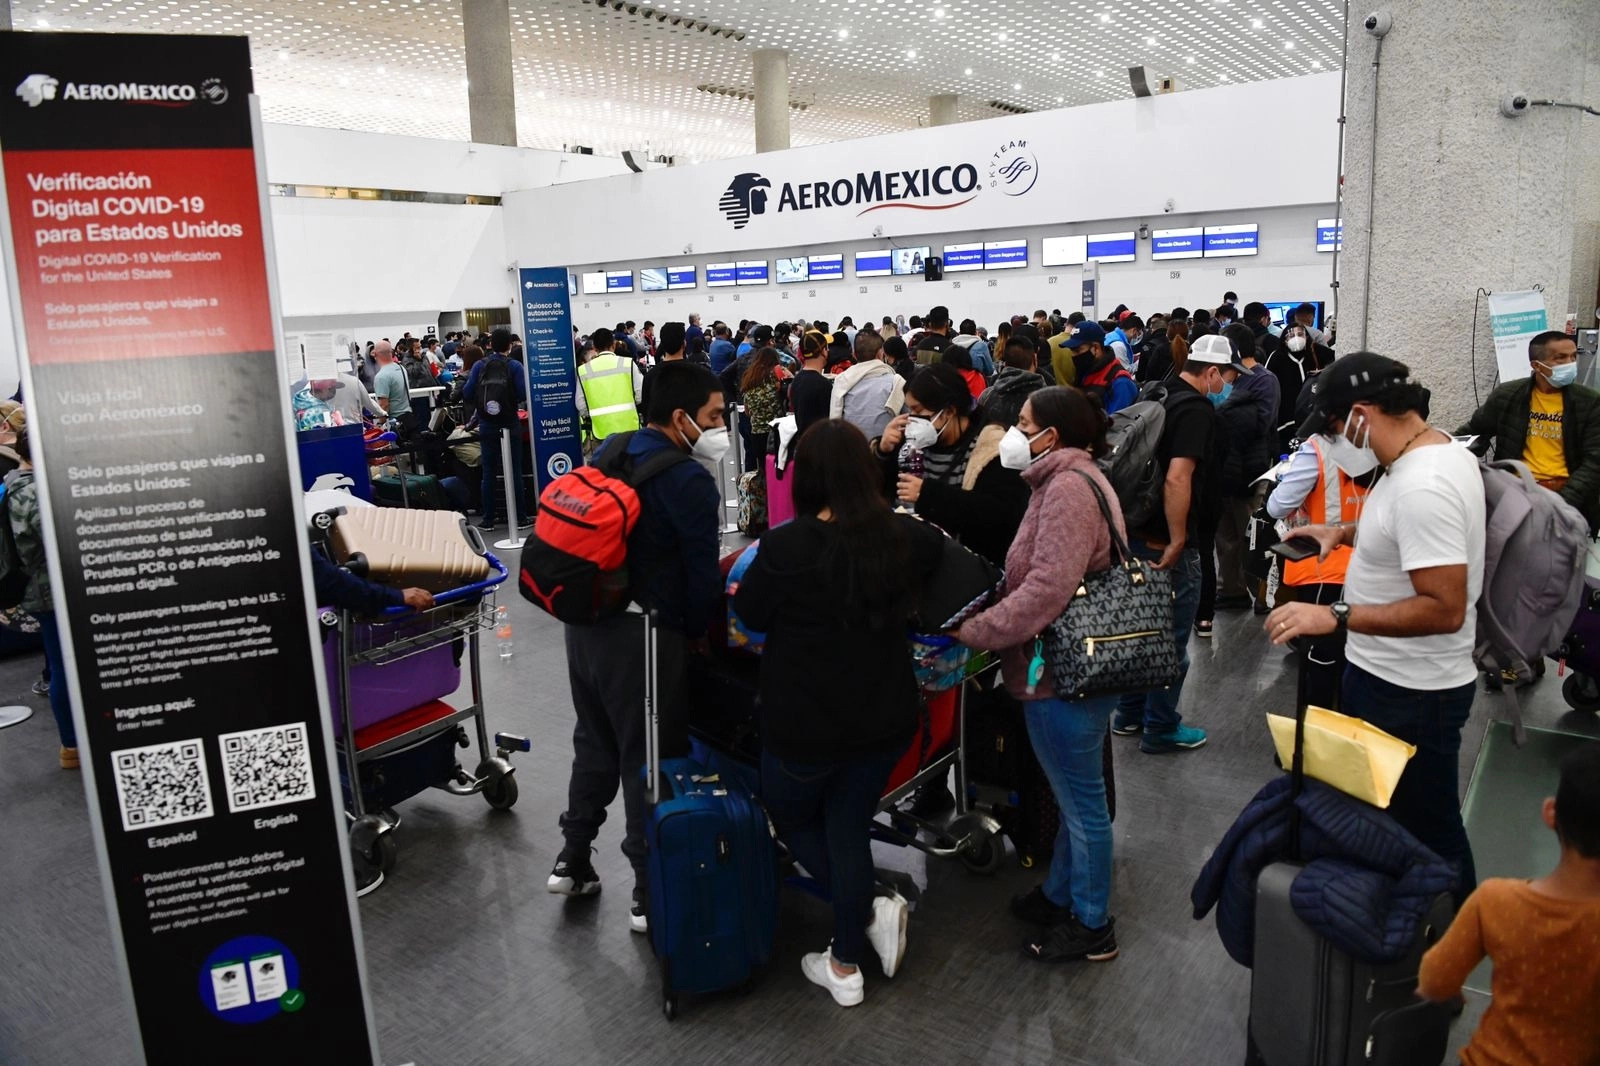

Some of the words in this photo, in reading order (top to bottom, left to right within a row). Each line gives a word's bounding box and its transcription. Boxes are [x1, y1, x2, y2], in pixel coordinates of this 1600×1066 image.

[63, 82, 196, 101] AEROMEXICO
[989, 139, 1027, 188] SKYTEAM
[27, 172, 151, 192] Verificación
[777, 163, 979, 213] AEROMEXICO
[32, 199, 99, 220] Digital
[103, 196, 205, 215] COVID-19
[35, 228, 82, 247] para
[86, 224, 169, 242] Estados
[172, 221, 243, 239] Unidos
[38, 254, 81, 269] Digital
[83, 252, 149, 267] COVID-19
[150, 250, 221, 264] Verification
[40, 272, 58, 284] for
[61, 271, 84, 283] the
[86, 269, 130, 282] United
[131, 267, 173, 280] States
[1049, 276, 1057, 284] 37
[1170, 271, 1180, 279] 39
[44, 302, 75, 316] Solo
[77, 299, 141, 316] pasajeros
[143, 299, 168, 312] que
[170, 296, 208, 311] viajan
[210, 297, 218, 307] a
[47, 317, 99, 331] Estados
[57, 390, 101, 407] Viaja
[60, 411, 94, 425] con
[540, 419, 557, 428] Viaja
[548, 426, 570, 435] seguro
[67, 466, 102, 481] Solo
[106, 460, 178, 479] pasajeros
[180, 458, 208, 473] que
[210, 453, 251, 469] viajan
[255, 453, 265, 464] a
[71, 480, 132, 498] Estados
[134, 477, 191, 493] Unidos:
[74, 504, 117, 521] Agiliza
[119, 503, 133, 516] tu
[135, 500, 187, 517] proceso
[188, 498, 205, 510] de
[76, 514, 176, 537] documentación
[176, 508, 244, 526] verificando
[246, 506, 267, 519] tus
[79, 532, 158, 552] documentos
[160, 529, 177, 543] de
[178, 526, 213, 541] salud
[81, 548, 154, 567] (Certificado
[155, 545, 174, 560] de
[175, 537, 246, 557] vacunación
[246, 535, 267, 551] y/o
[83, 563, 137, 582] Pruebas
[138, 560, 167, 575] PCR
[167, 561, 176, 572] o
[178, 556, 196, 571] de
[264, 548, 281, 561] de
[86, 579, 135, 596] manera
[136, 574, 178, 591] digital.
[90, 612, 116, 626] Only
[117, 604, 180, 623] passengers
[181, 598, 227, 614] traveling
[228, 597, 239, 609] to
[239, 594, 258, 607] the
[93, 632, 120, 643] Make
[120, 629, 141, 641] your
[182, 620, 218, 632] process
[246, 614, 258, 625] by
[95, 641, 135, 655] verifying
[135, 638, 156, 651] your
[157, 634, 186, 646] health
[186, 628, 237, 643] documents
[237, 624, 271, 637] digitally
[97, 656, 127, 667] before
[127, 652, 149, 664] your
[150, 648, 174, 660] flight
[228, 635, 273, 650] certificate
[99, 666, 130, 678] and/or
[240, 649, 258, 660] and
[258, 647, 279, 657] save
[101, 680, 122, 690] time
[122, 678, 133, 688] at
[133, 675, 149, 686] the
[114, 703, 163, 721] Ingresa
[116, 720, 141, 732] Enter
[254, 812, 299, 830] English
[147, 830, 198, 849] Español
[142, 860, 225, 884] Posteriormente
[226, 855, 250, 869] solo
[251, 849, 285, 864] debes
[145, 877, 197, 897] presentar
[198, 874, 210, 886] la
[210, 864, 272, 884] verificación
[272, 857, 305, 873] digital
[147, 899, 155, 909] a
[156, 889, 204, 908] nuestros
